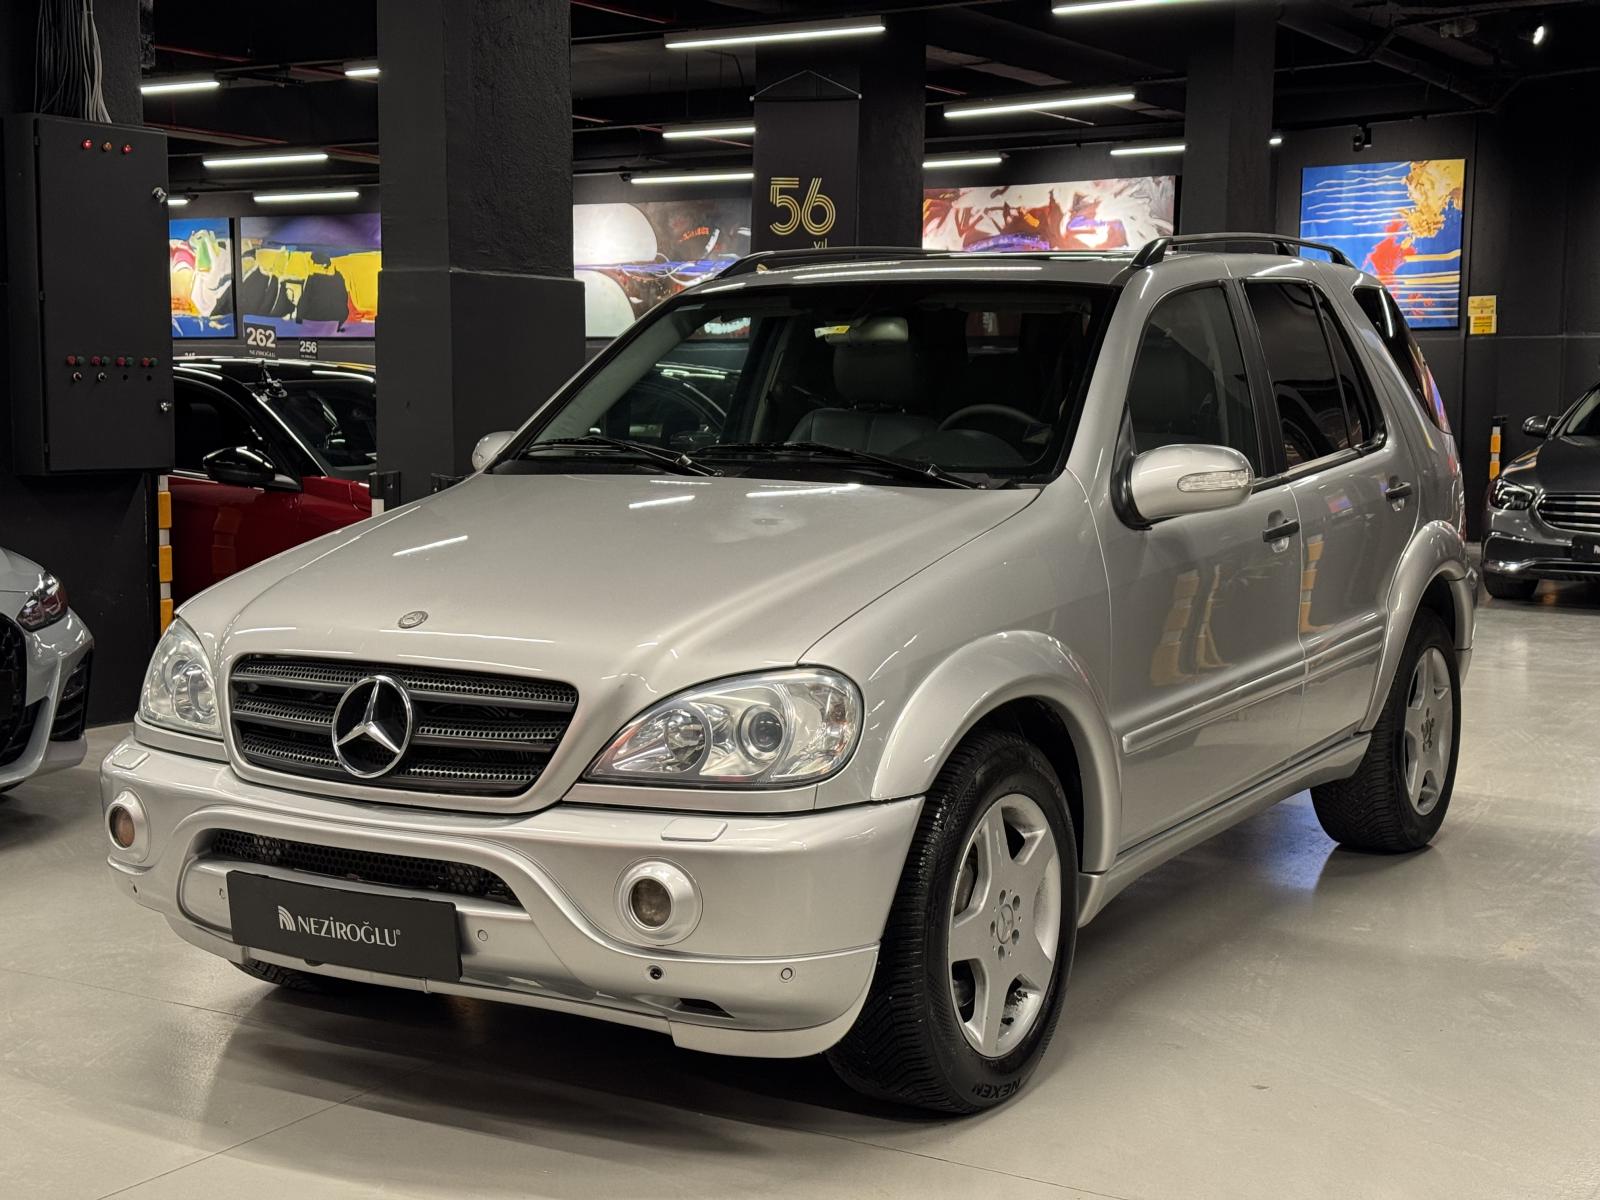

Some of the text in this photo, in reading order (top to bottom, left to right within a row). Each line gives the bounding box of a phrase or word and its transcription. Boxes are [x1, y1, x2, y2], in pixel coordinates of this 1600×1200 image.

[769, 177, 836, 236] 56
[246, 327, 276, 348] 262
[300, 341, 317, 353] 256
[971, 1078, 1021, 1099] NEXEN
